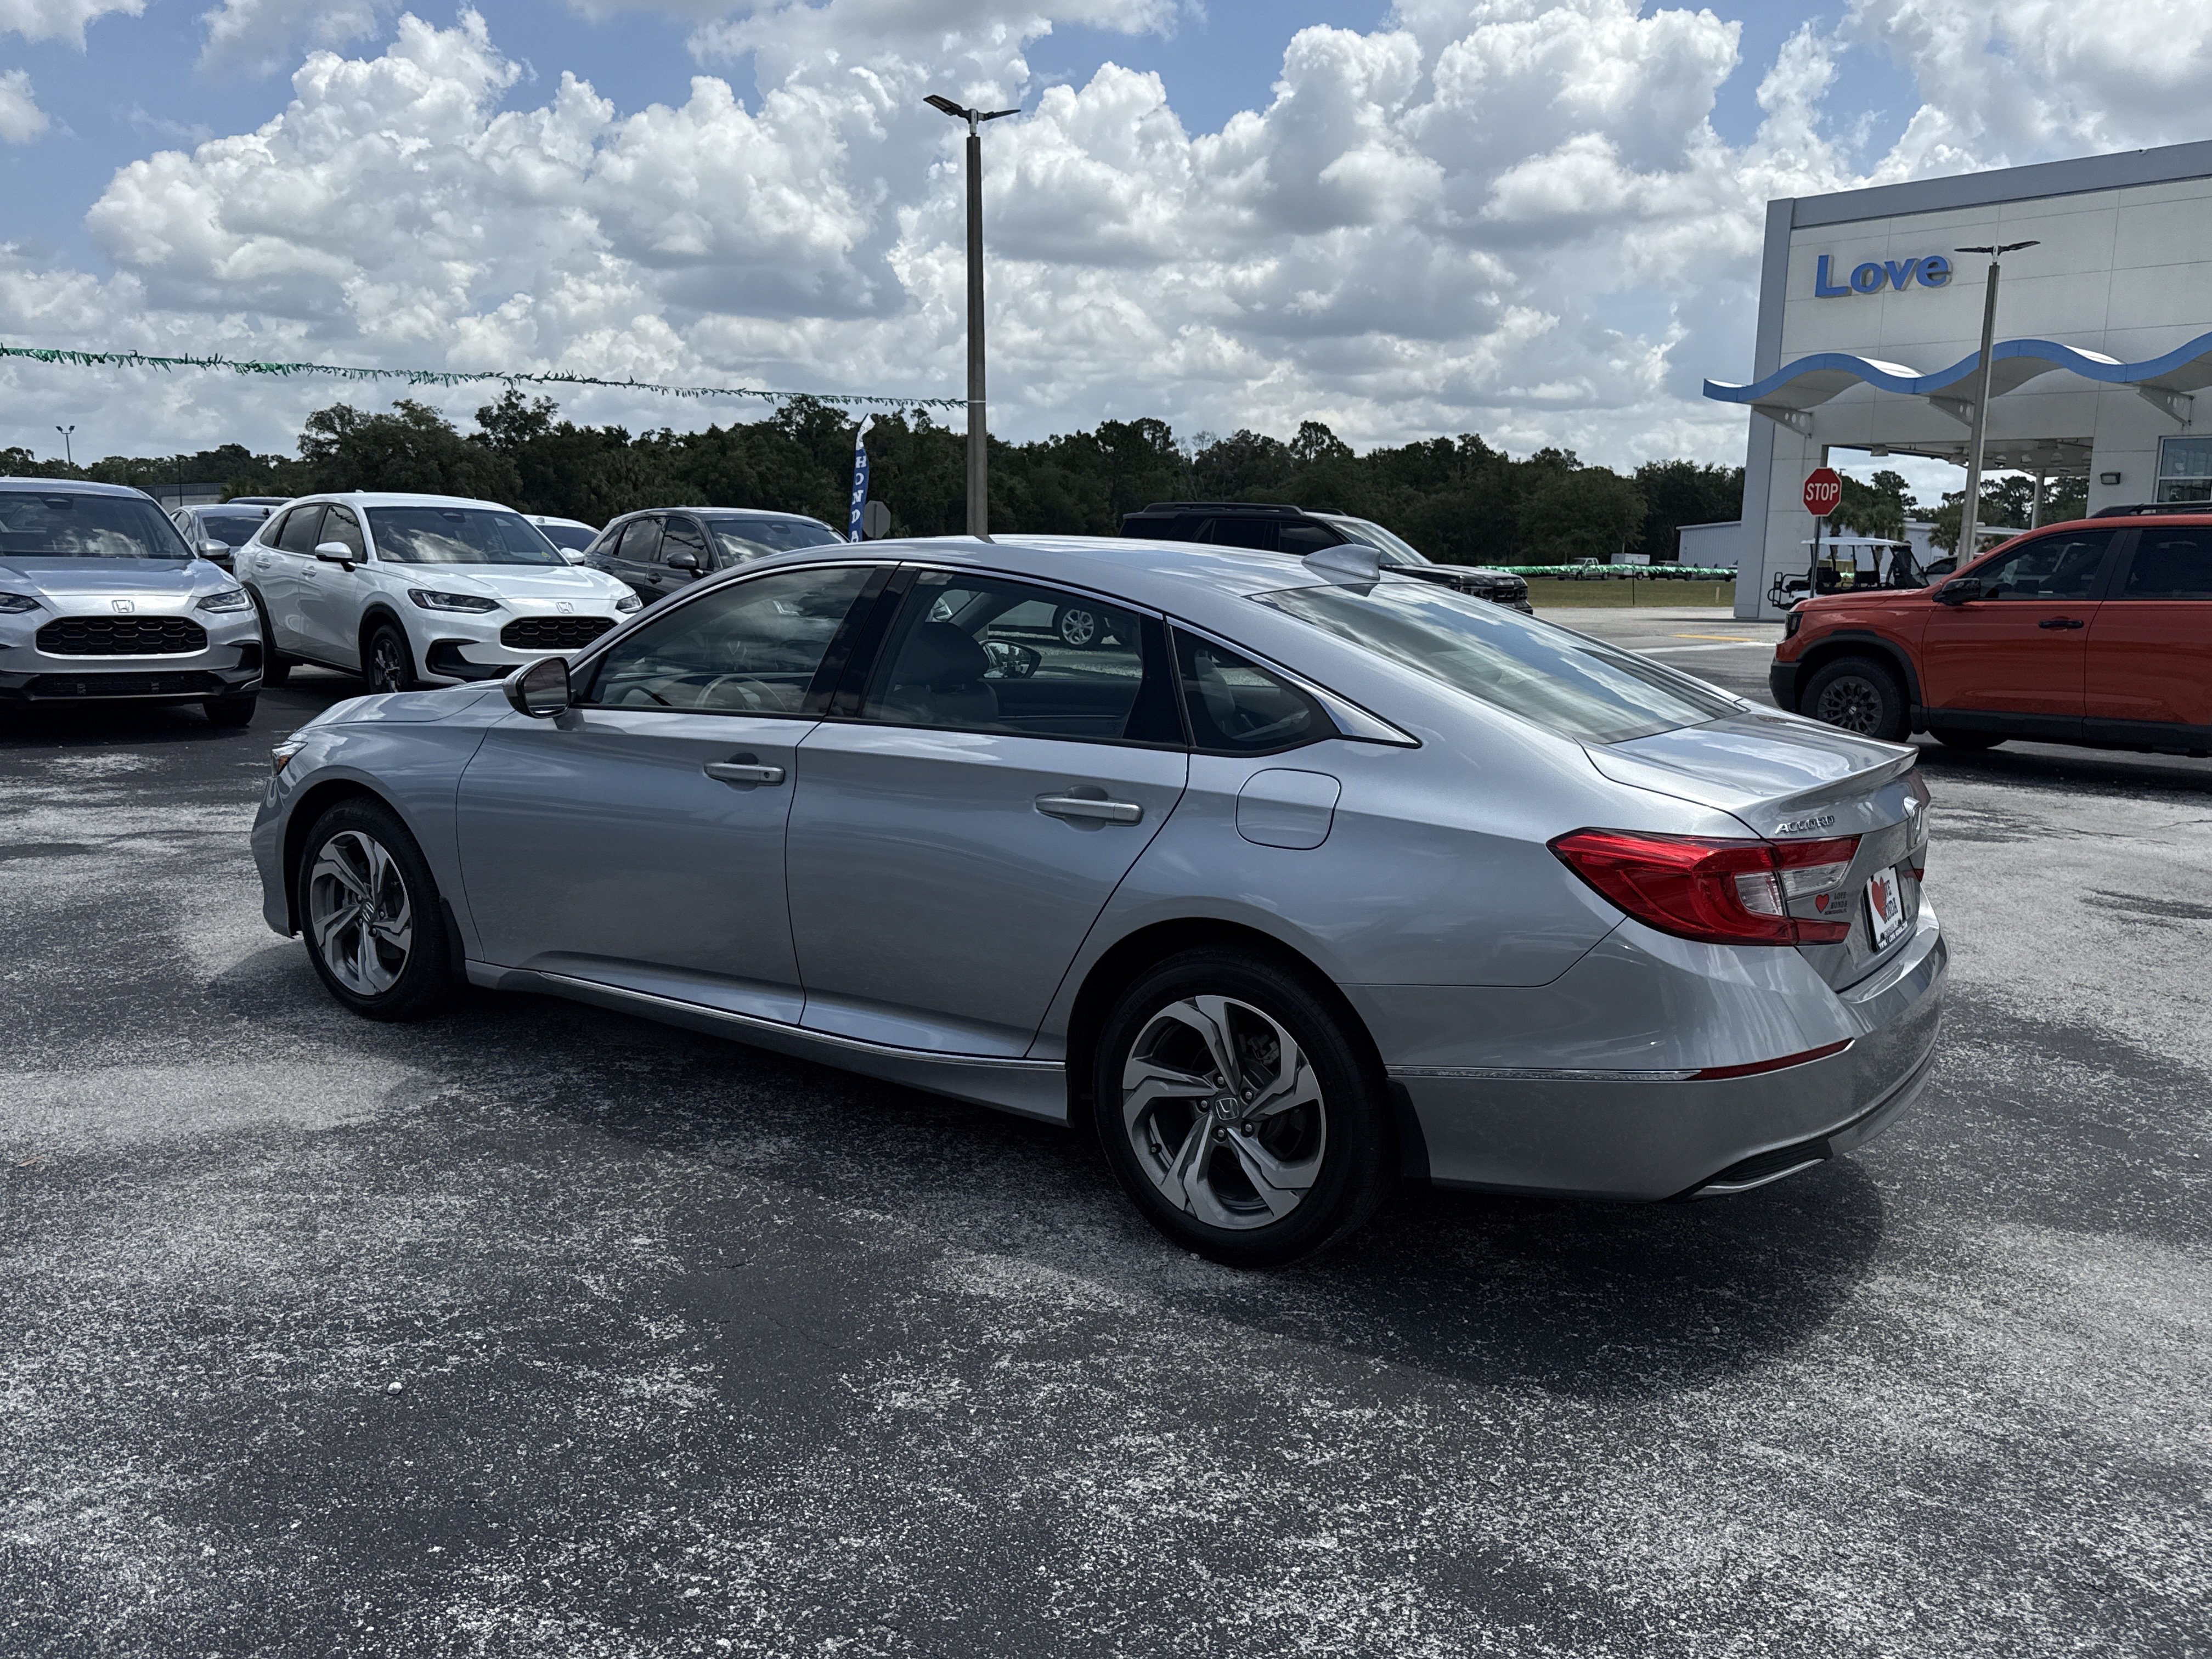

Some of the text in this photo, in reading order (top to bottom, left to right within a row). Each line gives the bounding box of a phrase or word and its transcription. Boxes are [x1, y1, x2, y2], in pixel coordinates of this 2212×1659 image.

[1815, 254, 1950, 297] Love
[850, 456, 867, 543] HONDA
[1805, 483, 1838, 501] STOP
[1774, 815, 1835, 834] ACCORD
[1882, 896, 1899, 924] ONDA
[1119, 985, 1154, 1025] ENERGY
